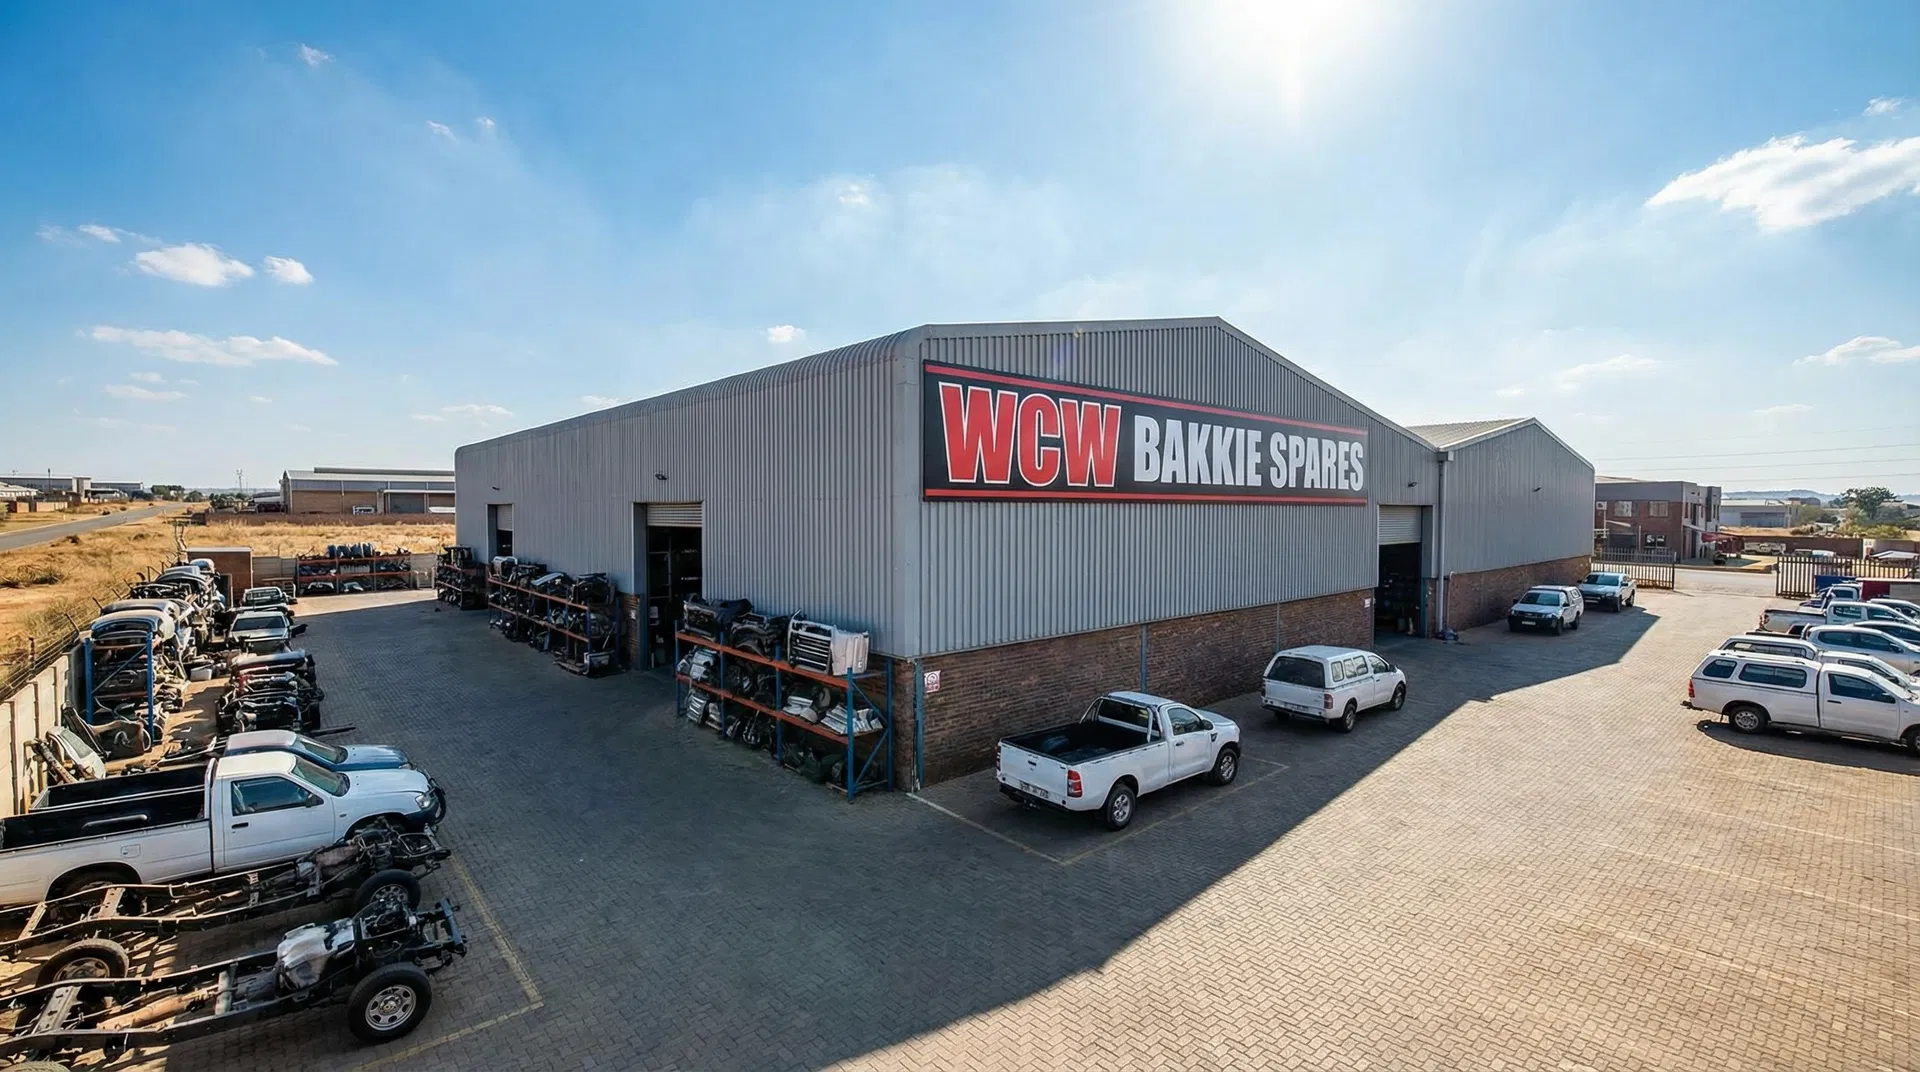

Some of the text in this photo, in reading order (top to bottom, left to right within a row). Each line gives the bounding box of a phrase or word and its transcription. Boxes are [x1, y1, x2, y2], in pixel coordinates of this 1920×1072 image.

[938, 381, 1364, 491] WCW BAKKIE SPARES
